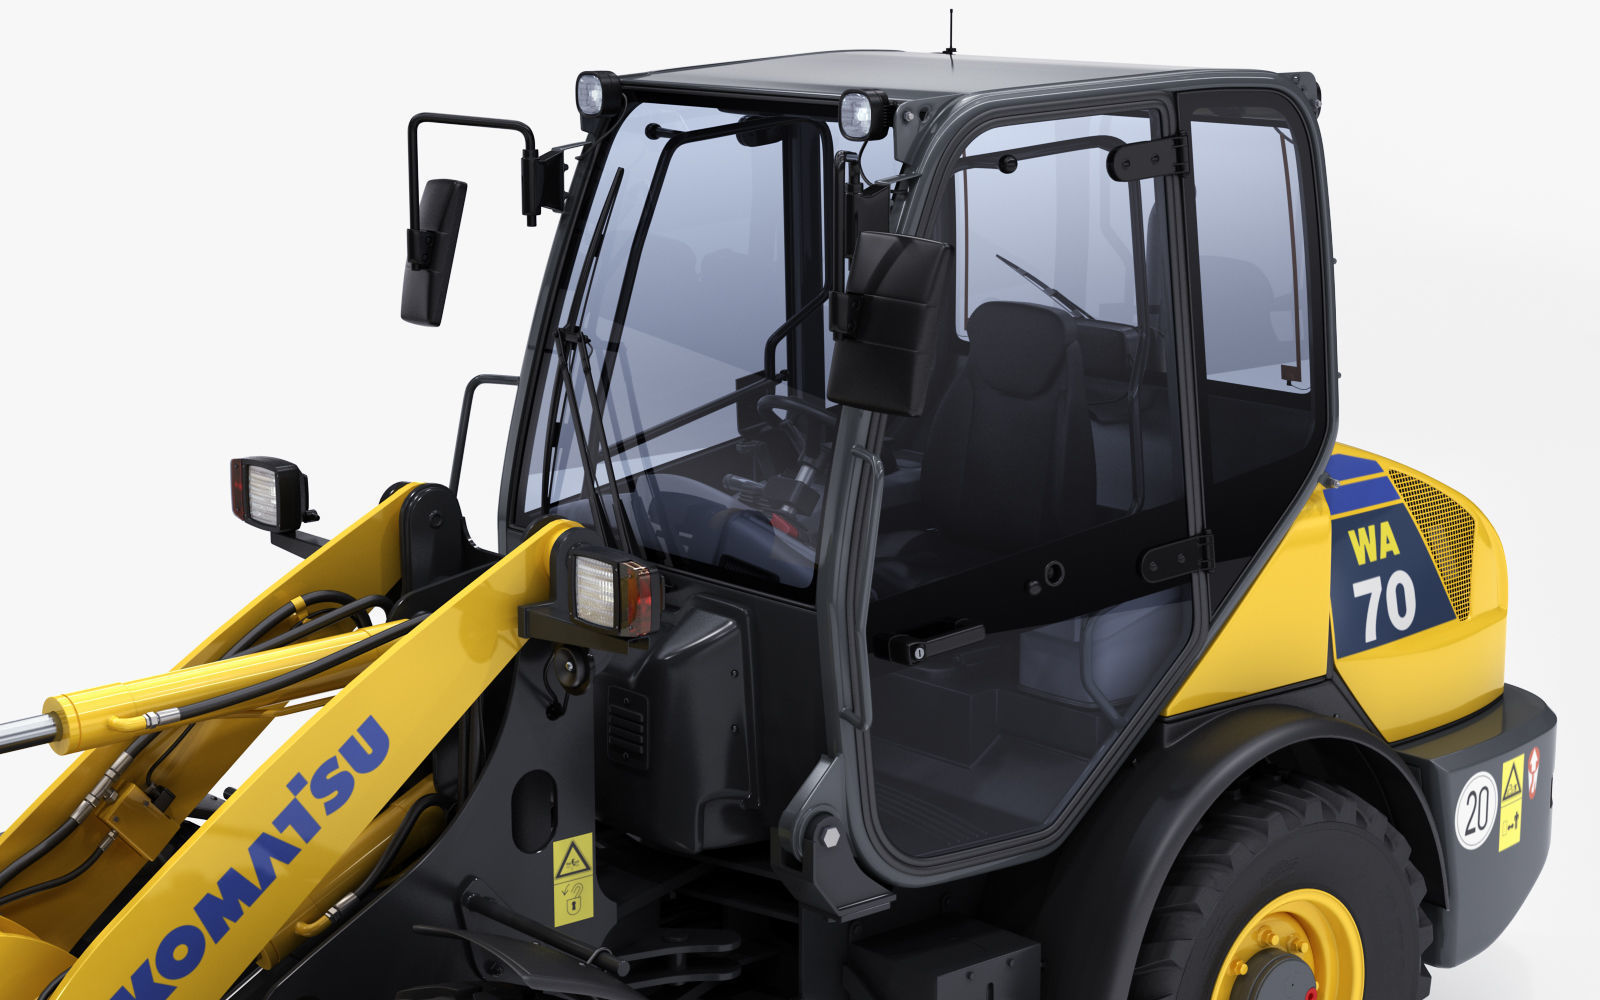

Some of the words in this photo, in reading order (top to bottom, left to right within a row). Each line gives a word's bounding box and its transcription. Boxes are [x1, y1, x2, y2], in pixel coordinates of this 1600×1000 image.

[1348, 520, 1400, 566] WA
[1352, 570, 1417, 643] 70
[1465, 786, 1489, 836] 20
